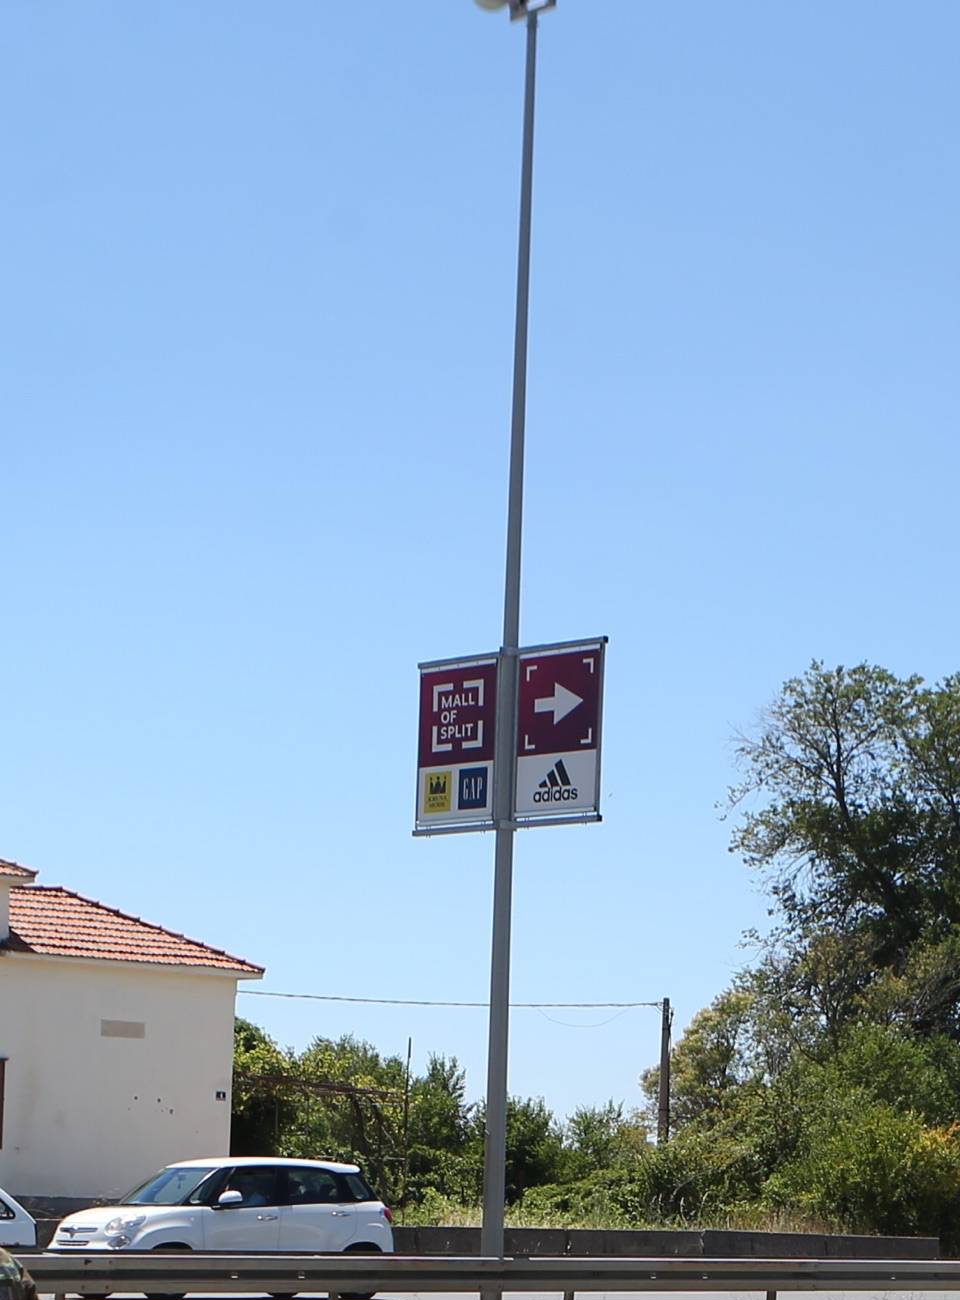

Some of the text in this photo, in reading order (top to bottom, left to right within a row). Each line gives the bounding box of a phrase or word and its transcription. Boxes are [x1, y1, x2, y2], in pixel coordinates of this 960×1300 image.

[441, 693, 475, 709] MALL
[440, 710, 458, 724] OF
[440, 723, 474, 740] SPLIT
[462, 776, 483, 801] GAP
[533, 786, 578, 803] adidas
